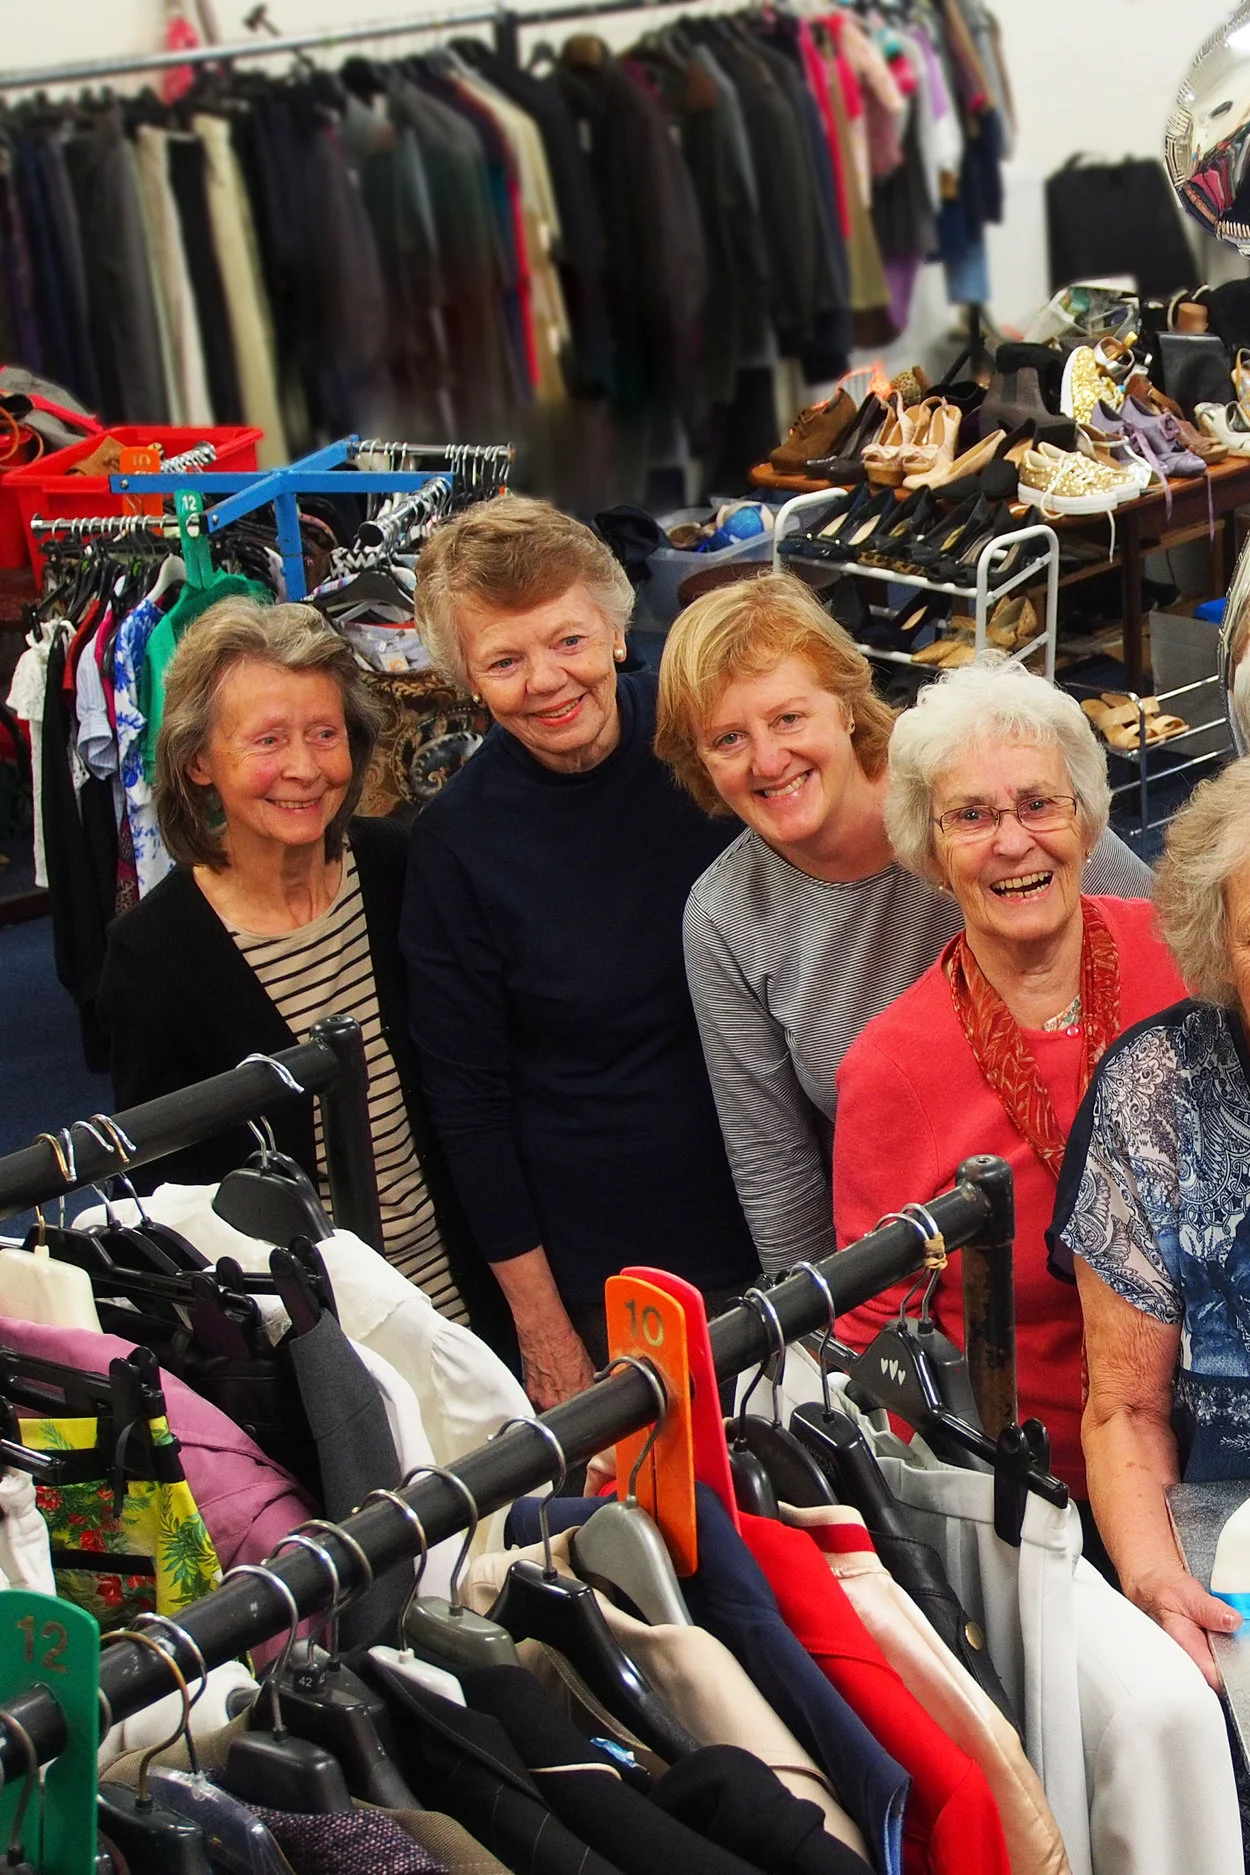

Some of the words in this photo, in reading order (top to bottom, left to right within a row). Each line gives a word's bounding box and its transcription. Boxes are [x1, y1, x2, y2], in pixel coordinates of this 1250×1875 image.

[130, 453, 151, 469] 10
[182, 495, 197, 511] 12
[624, 1299, 664, 1348] 10
[16, 1615, 69, 1674] 12
[299, 1676, 313, 1688] 42
